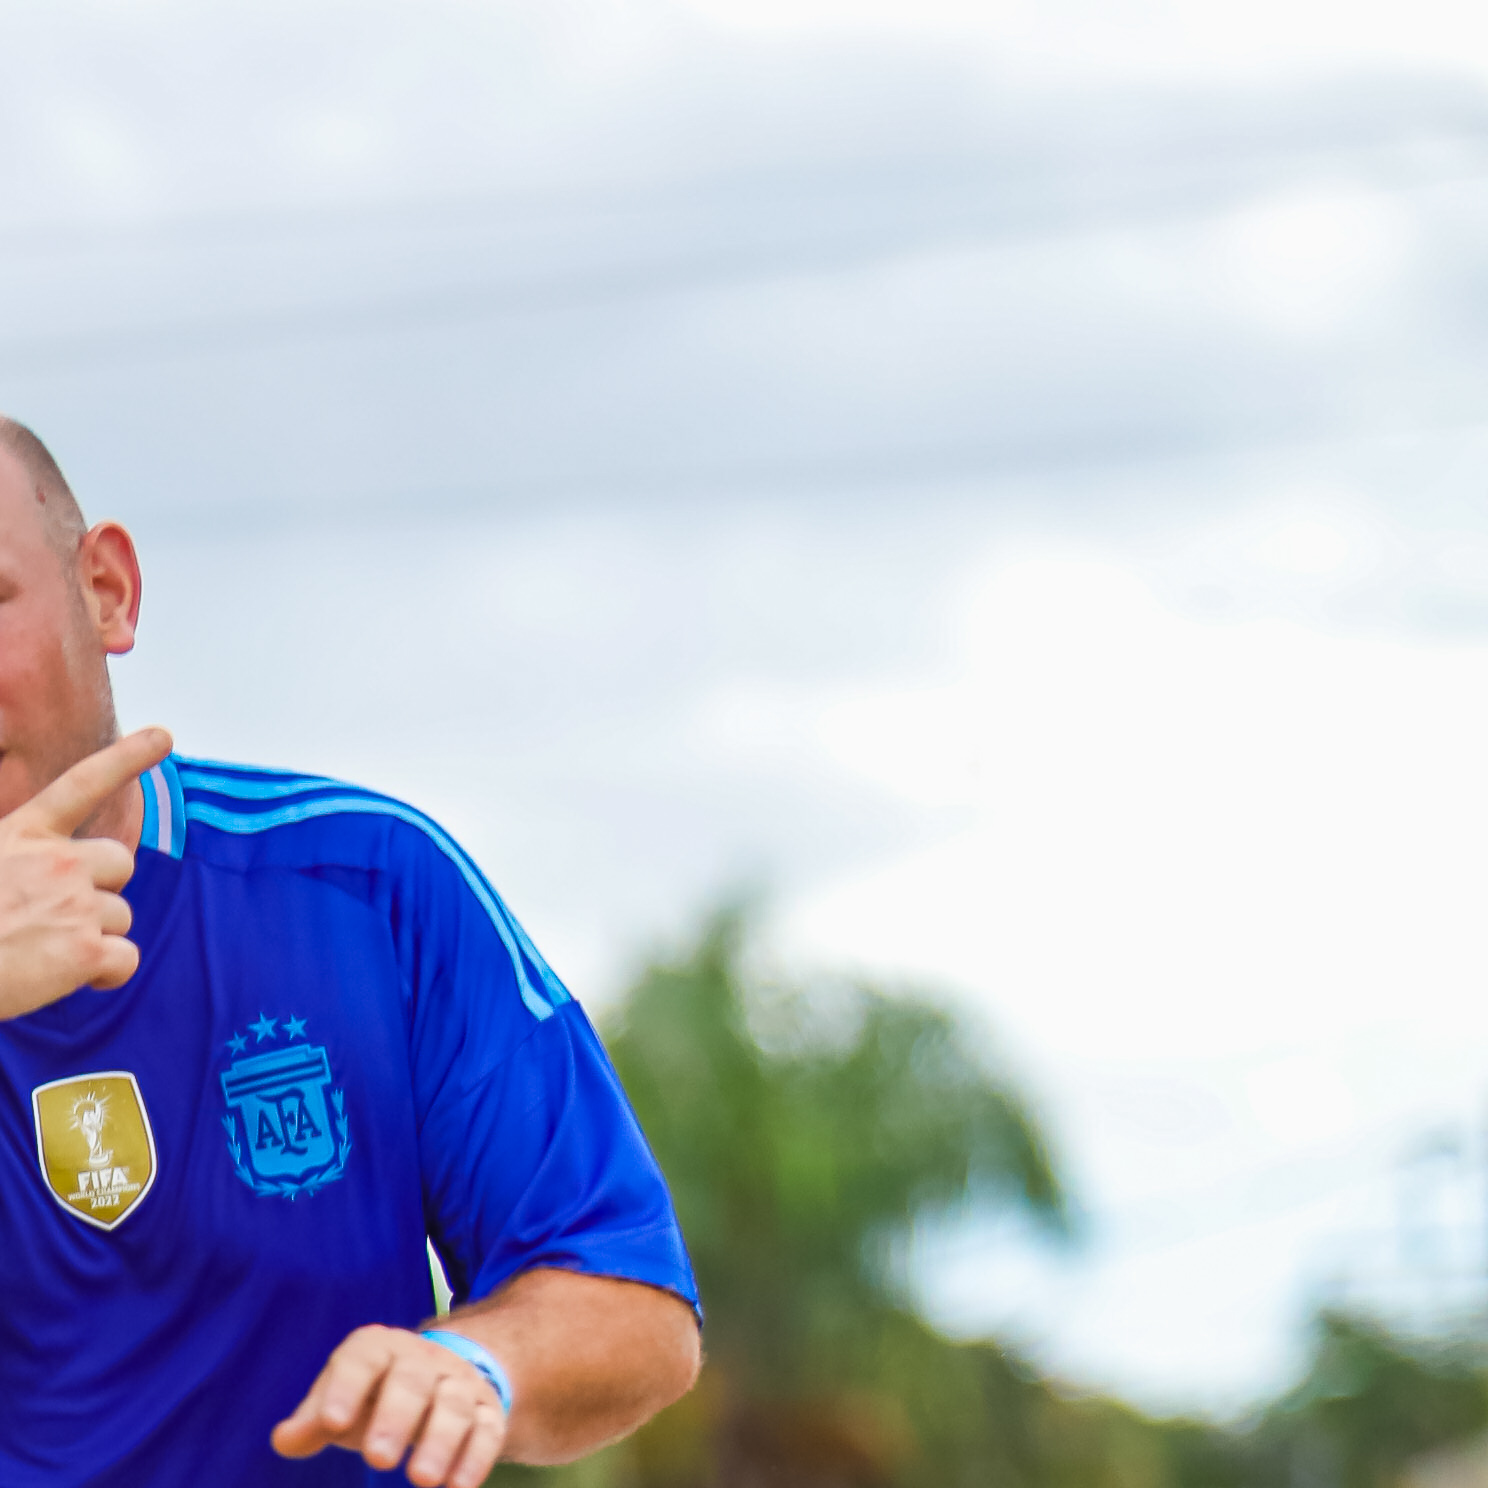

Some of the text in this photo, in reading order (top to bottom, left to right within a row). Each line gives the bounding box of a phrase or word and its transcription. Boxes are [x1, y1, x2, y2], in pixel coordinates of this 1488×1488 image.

[255, 1087, 322, 1155] AFA
[77, 1166, 129, 1193] FIFA
[91, 1194, 120, 1209] 2022
